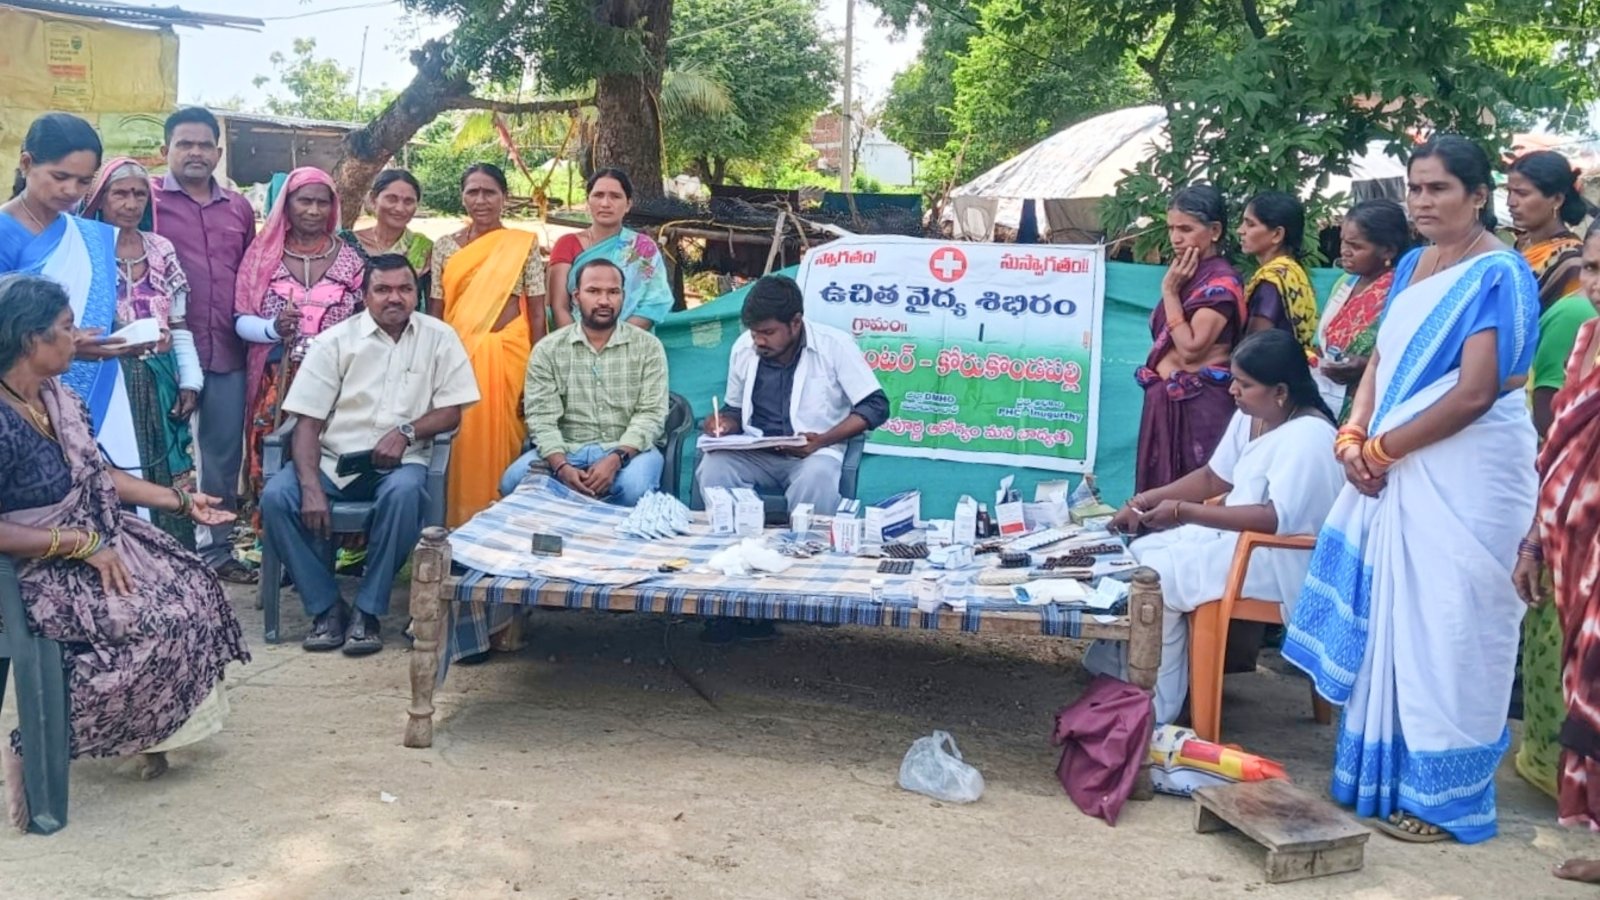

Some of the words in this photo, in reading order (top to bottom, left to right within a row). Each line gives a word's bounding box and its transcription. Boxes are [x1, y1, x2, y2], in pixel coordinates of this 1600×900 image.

[819, 281, 899, 304] ఉచిత
[904, 286, 967, 317] వైద్య
[864, 344, 916, 373] ంటర్
